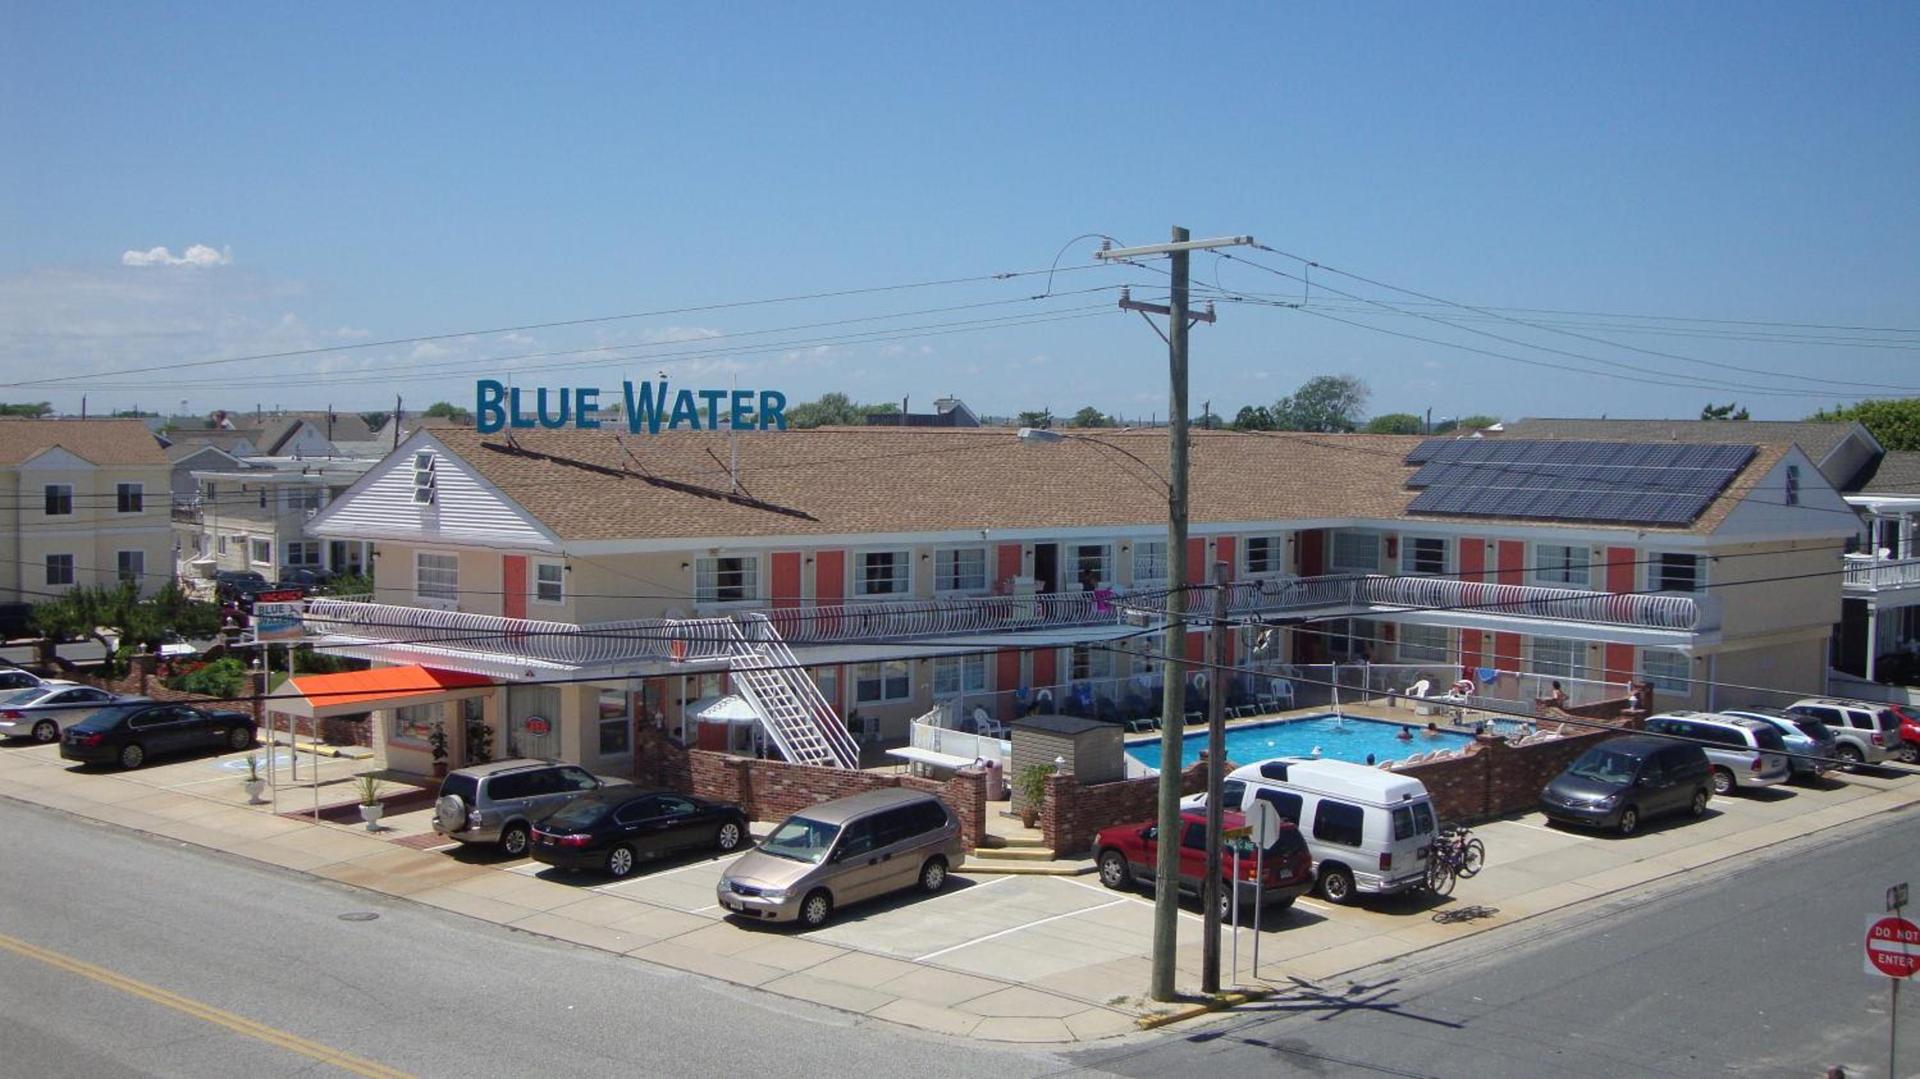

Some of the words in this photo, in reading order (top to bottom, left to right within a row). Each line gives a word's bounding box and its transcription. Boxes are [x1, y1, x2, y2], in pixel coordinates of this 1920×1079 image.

[476, 379, 600, 434] BLUE
[623, 380, 787, 435] WATER
[258, 604, 286, 616] BLUE
[1875, 926, 1890, 938] DO
[1896, 929, 1919, 942] NOT
[1878, 952, 1914, 968] ENTER
